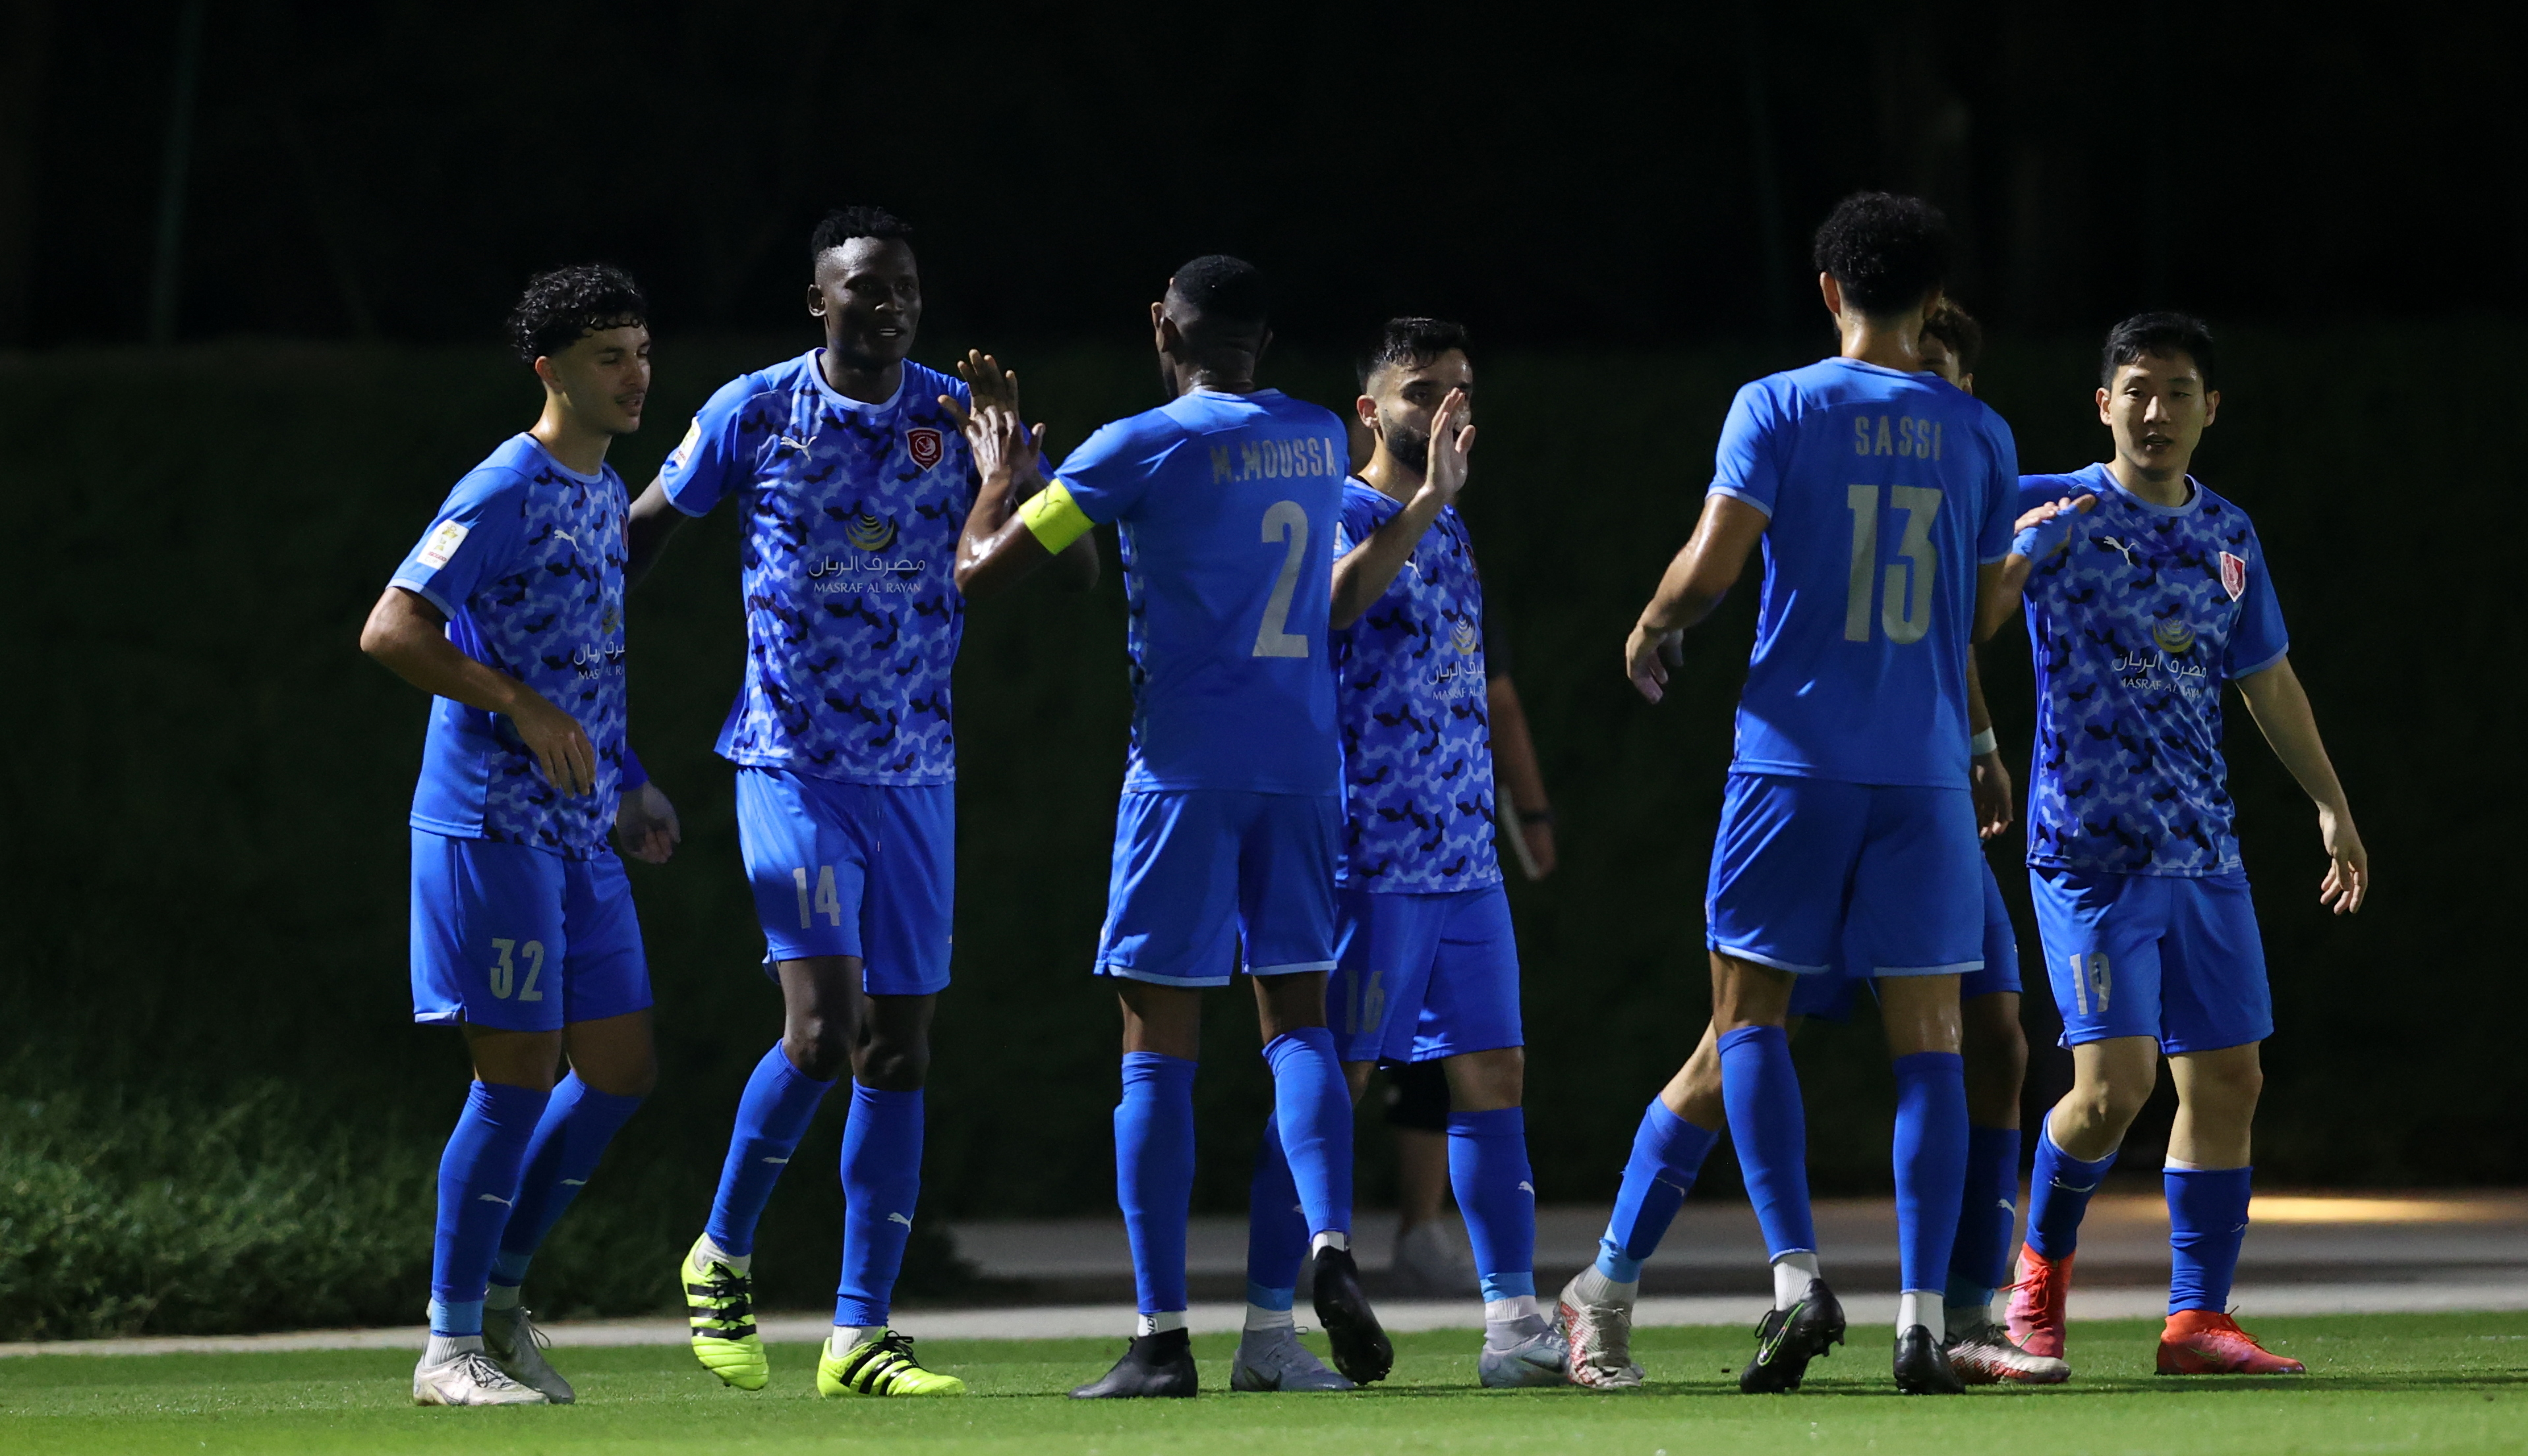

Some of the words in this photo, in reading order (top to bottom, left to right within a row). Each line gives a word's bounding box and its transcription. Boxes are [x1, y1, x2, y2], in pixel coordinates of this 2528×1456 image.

[1210, 437, 1338, 484] M.MOUSSA
[1854, 415, 1941, 461] SASSI
[809, 555, 860, 577] الريان
[813, 582, 863, 593] MASRAF
[867, 582, 881, 593] AL
[886, 582, 922, 593] RAYAN
[862, 555, 926, 578] مصرف
[1252, 499, 1309, 658] 2
[1845, 484, 1943, 644] 13
[2111, 650, 2162, 673] الريان
[2166, 658, 2207, 681] مصرف
[792, 864, 841, 930] 14
[490, 937, 544, 1001] 32
[2069, 951, 2112, 1015] 19
[1345, 970, 1385, 1035] 16
